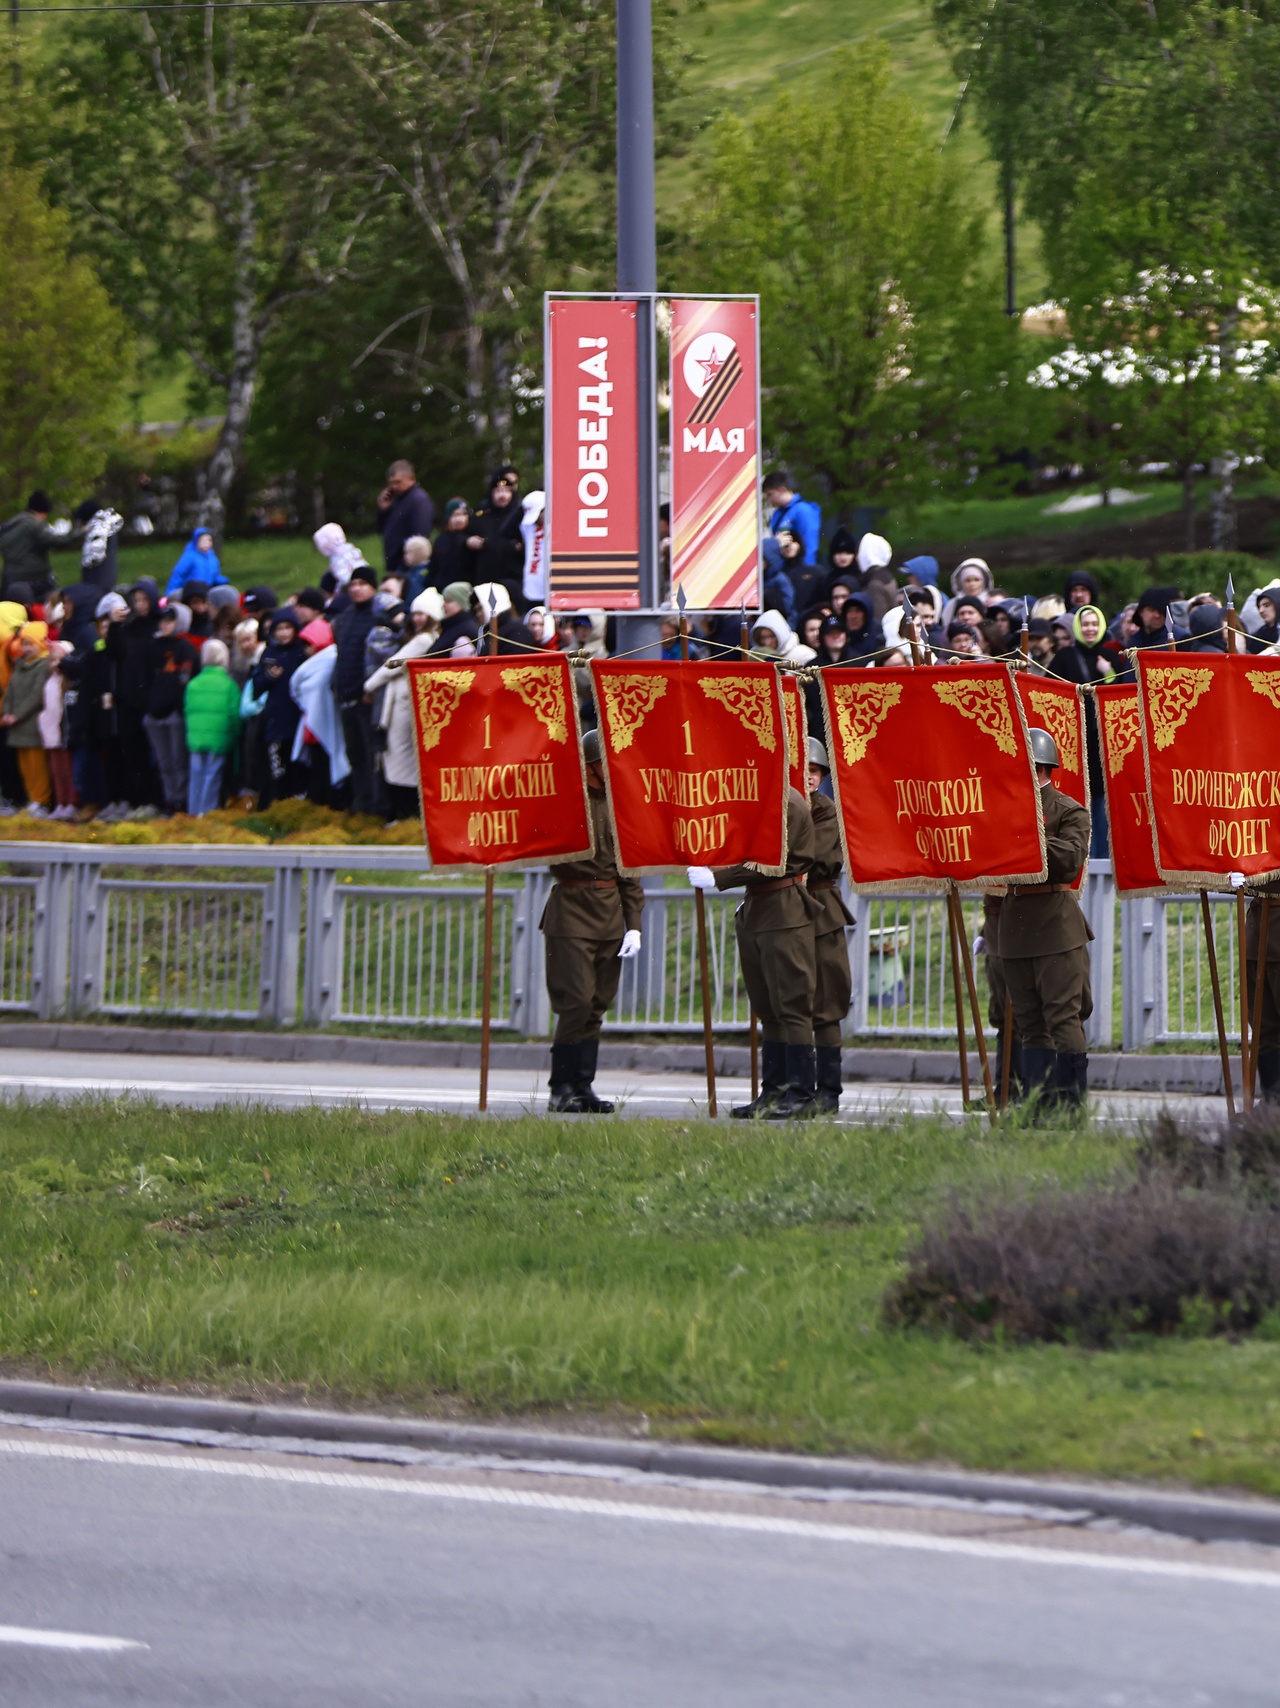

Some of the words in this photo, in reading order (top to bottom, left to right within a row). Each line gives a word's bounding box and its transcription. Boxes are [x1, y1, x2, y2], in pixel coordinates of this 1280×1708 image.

[578, 336, 613, 537] ПОБЕДА!
[683, 427, 745, 453] МАЯ
[482, 714, 493, 749] 1
[682, 720, 695, 755] 1
[638, 758, 759, 807] УКРАИНСКИЙ
[894, 767, 985, 824] ДОНСКОЙ
[915, 826, 972, 863] ФРОНТ
[1209, 818, 1271, 858] ФРОНТ
